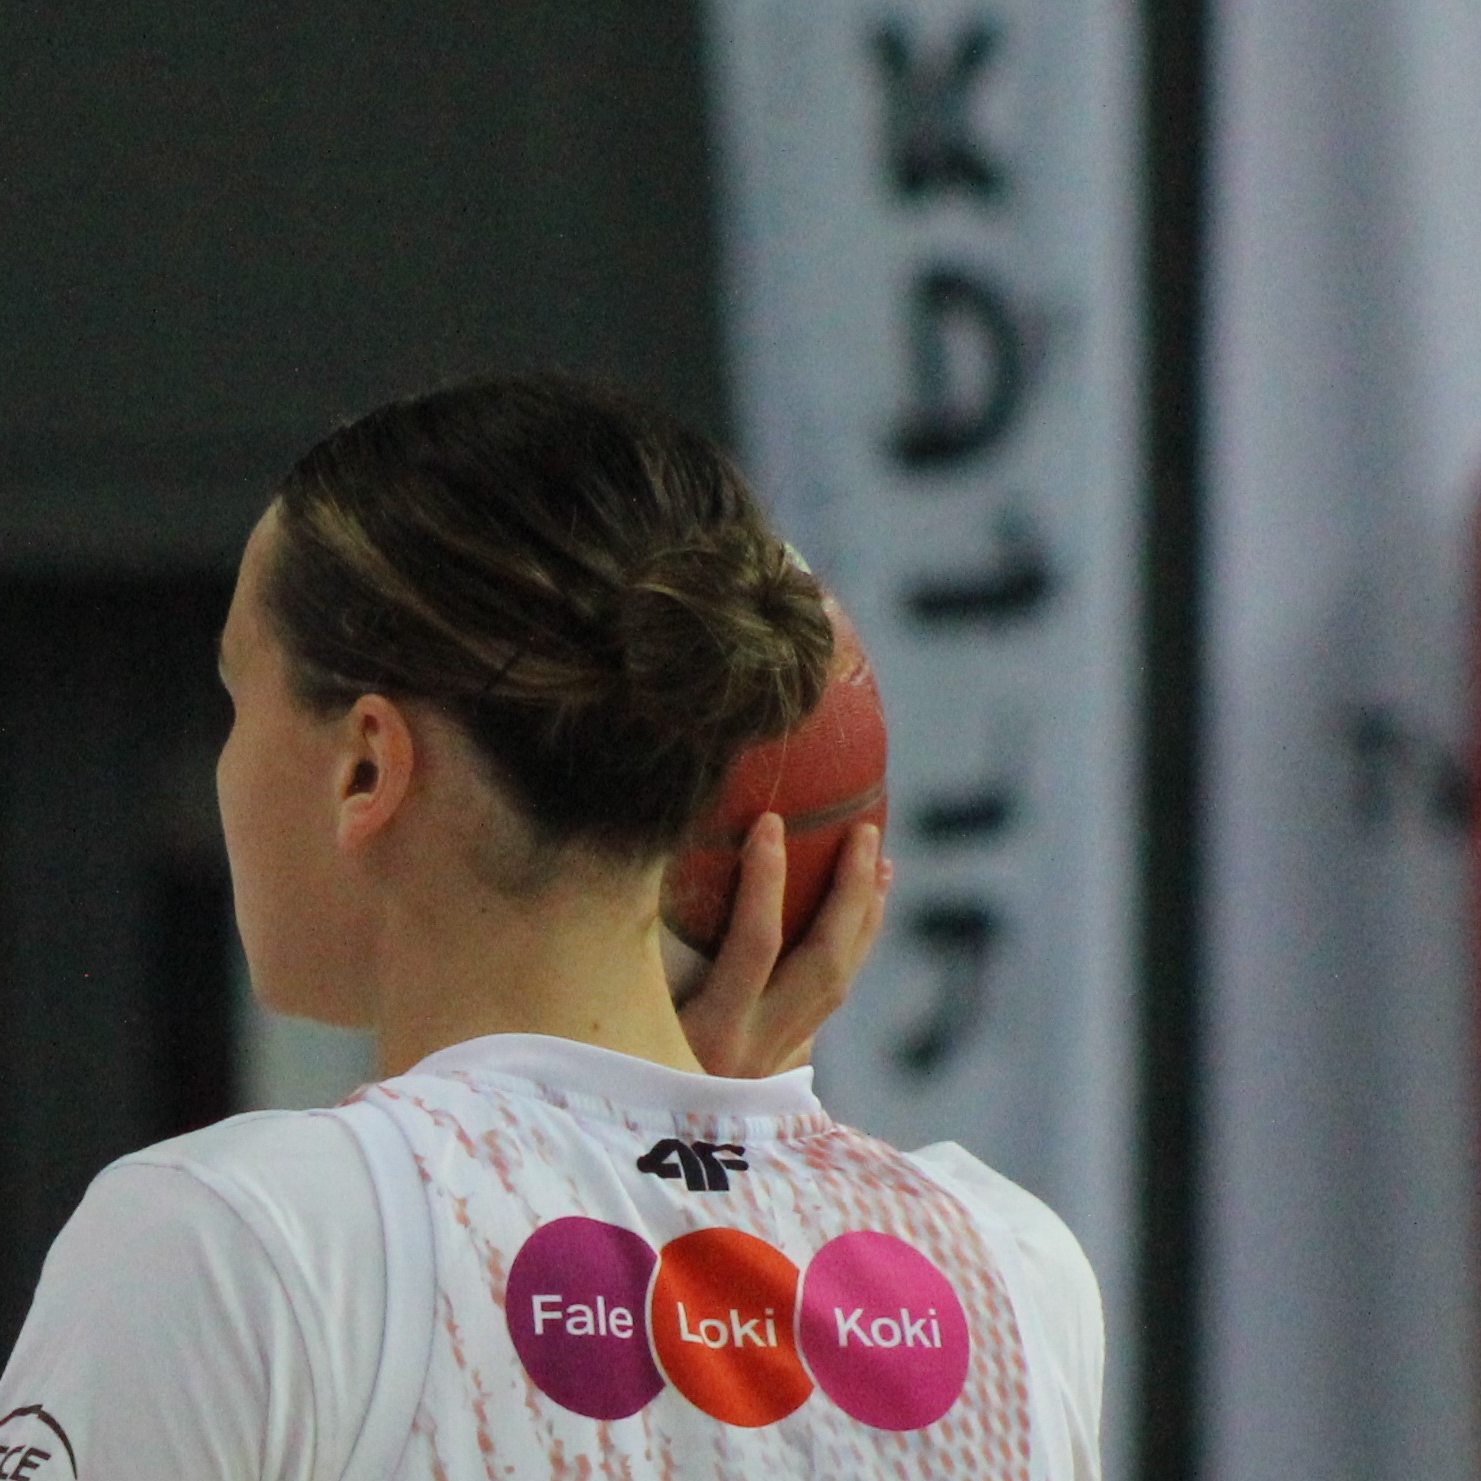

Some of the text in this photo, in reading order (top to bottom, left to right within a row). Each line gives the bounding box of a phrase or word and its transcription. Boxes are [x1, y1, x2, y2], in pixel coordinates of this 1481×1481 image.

[636, 1137, 750, 1192] 4F
[531, 1294, 943, 1350] Fale Loki Koki
